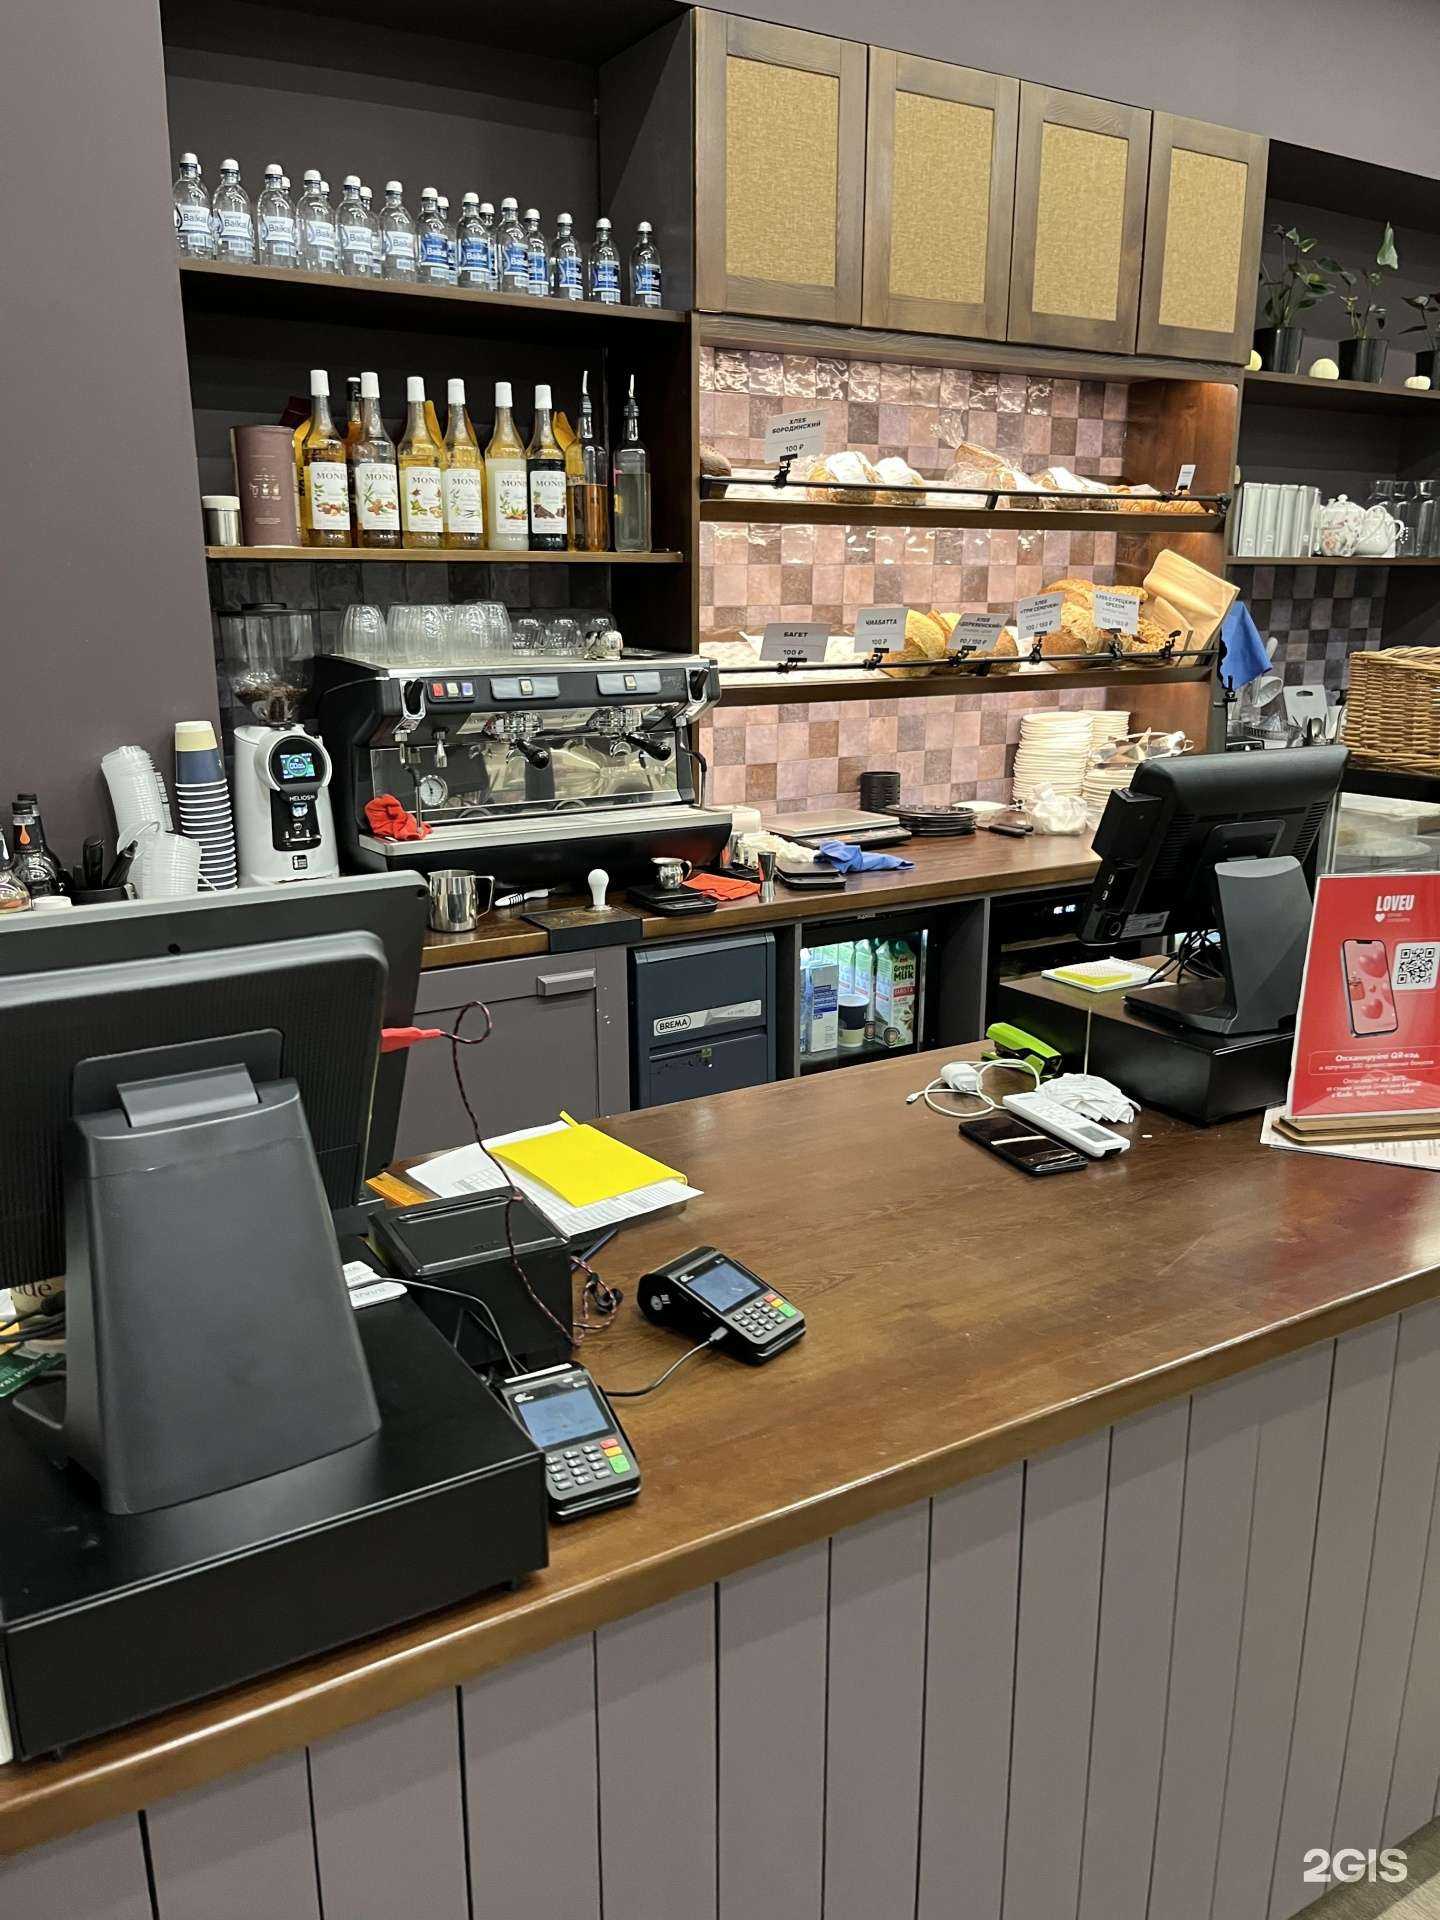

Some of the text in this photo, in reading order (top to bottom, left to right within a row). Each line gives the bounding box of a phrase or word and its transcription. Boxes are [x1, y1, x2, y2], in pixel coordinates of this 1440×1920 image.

[772, 420, 821, 434] БОРОДИНСКИЙ
[785, 445, 798, 453] 100
[1375, 894, 1415, 912] LOVEU
[893, 970, 914, 982] Milk
[659, 1017, 688, 1031] BREMA
